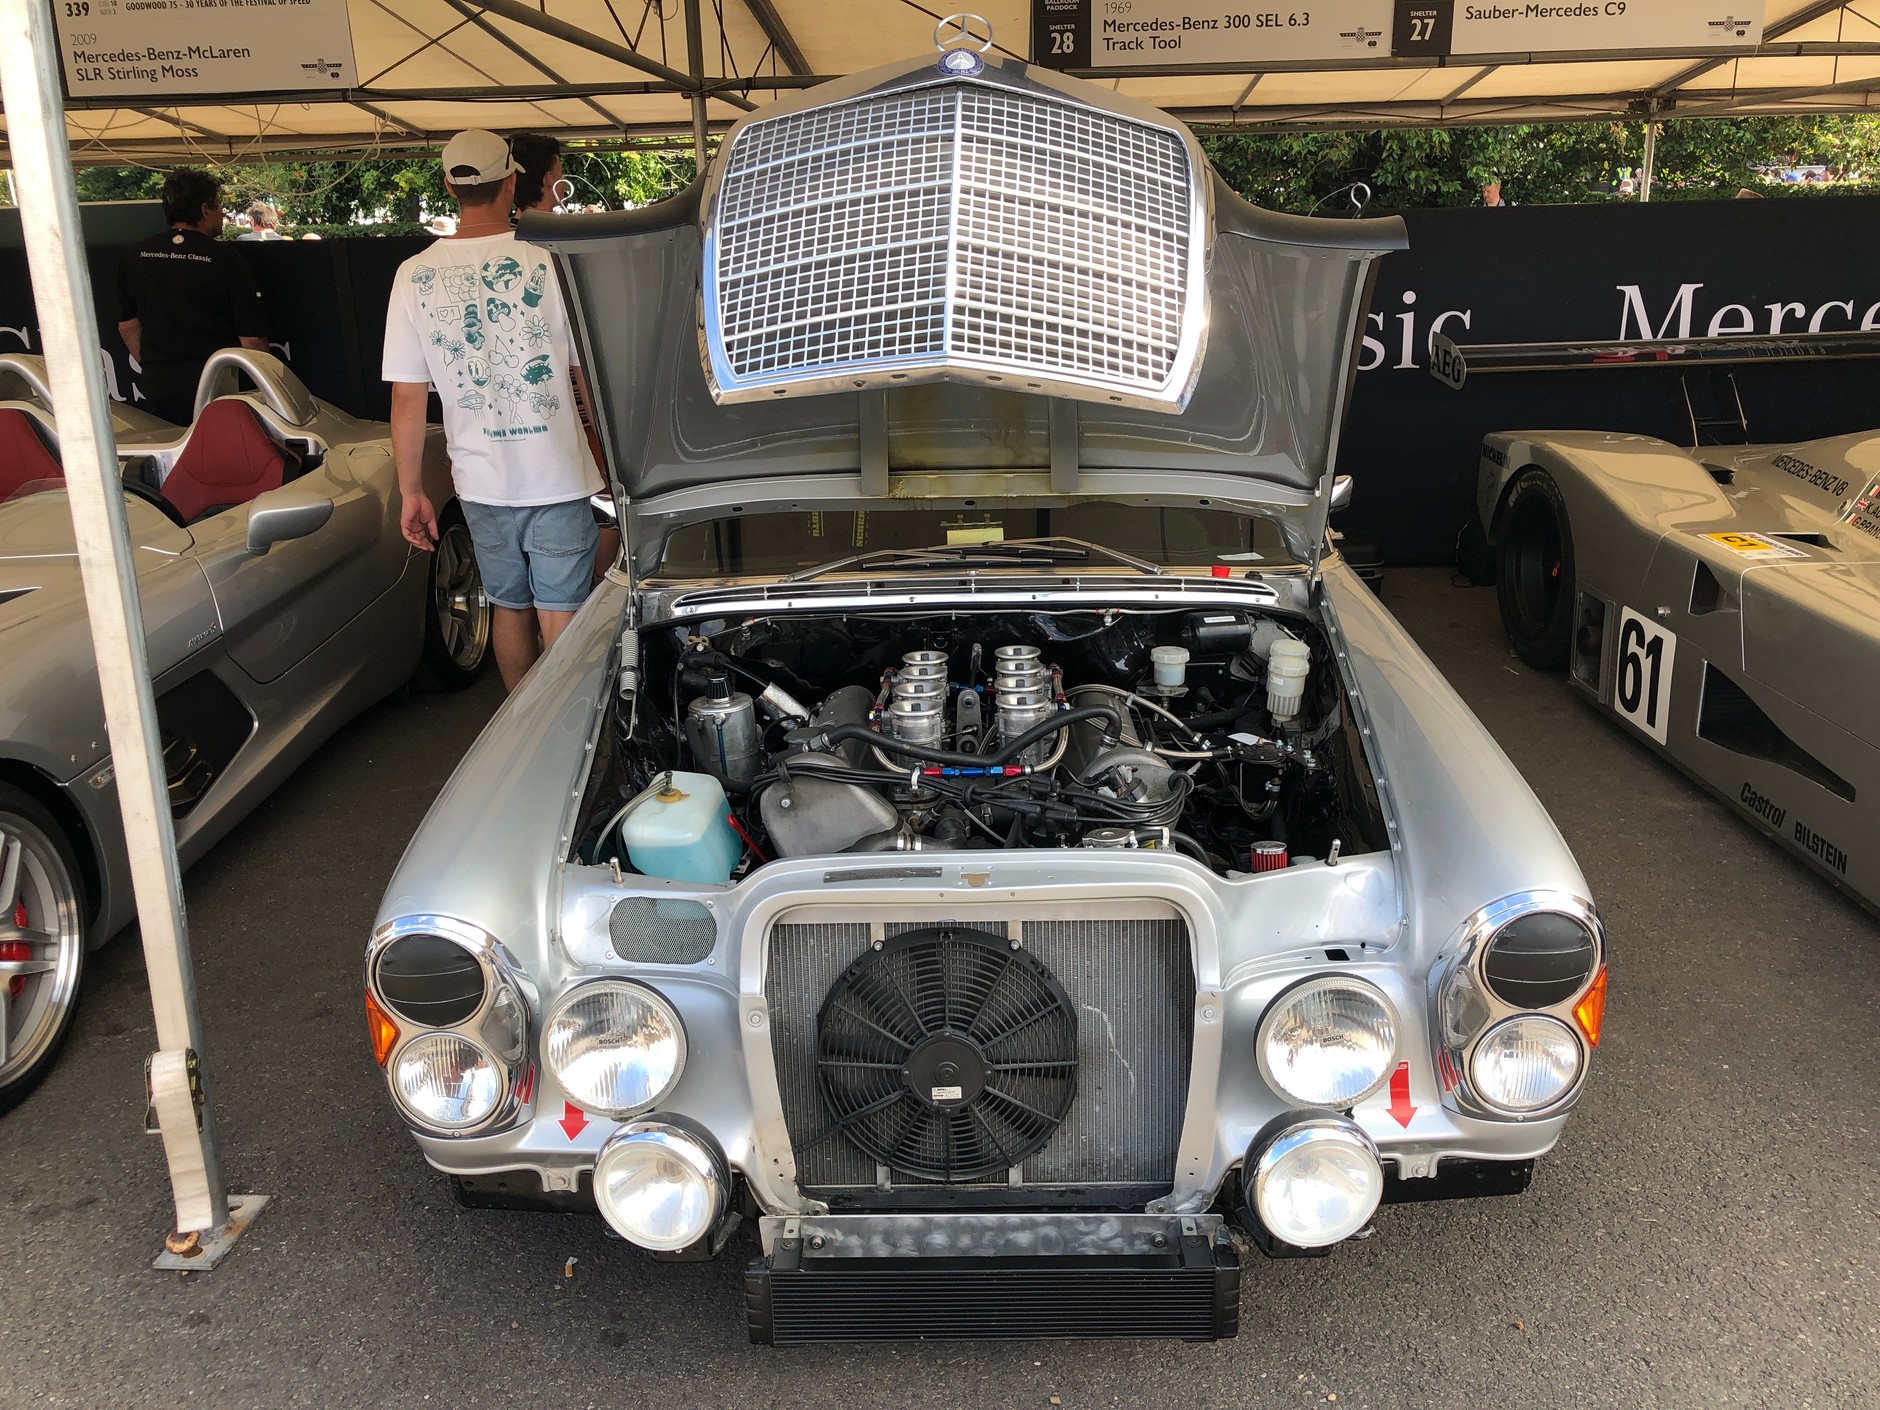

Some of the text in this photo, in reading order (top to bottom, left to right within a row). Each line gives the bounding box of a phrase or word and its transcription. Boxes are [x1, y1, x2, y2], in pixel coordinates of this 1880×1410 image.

[65, 2, 89, 17] 339
[125, 1, 167, 11] GOODWOOD
[169, 1, 178, 9] 75
[185, 0, 195, 8] 30
[196, 0, 218, 8] YEARS
[1103, 2, 1132, 14] 1969
[1465, 2, 1626, 20] Sauber-Mercedes C9
[1103, 12, 1310, 33] Mercedes-Benz 300 SEL 6.3
[1410, 19, 1436, 41] 27
[70, 33, 97, 46] 2009
[1050, 31, 1075, 54] 28
[1102, 35, 1182, 51] Track Tool
[73, 45, 251, 64] Mercedes-Benz-McLaren
[76, 64, 199, 83] SLR Stirling Moss
[140, 251, 212, 263] Mercedes-Benz Classic
[1431, 344, 1462, 384] AEG
[1769, 454, 1839, 492] MERCEDES-BENZ
[1831, 478, 1849, 497] V8
[1721, 535, 1759, 548] C1
[1617, 617, 1664, 729] 61
[1739, 782, 1848, 876] Castrol BILSTEIN
[1322, 1034, 1344, 1043] BOSCH
